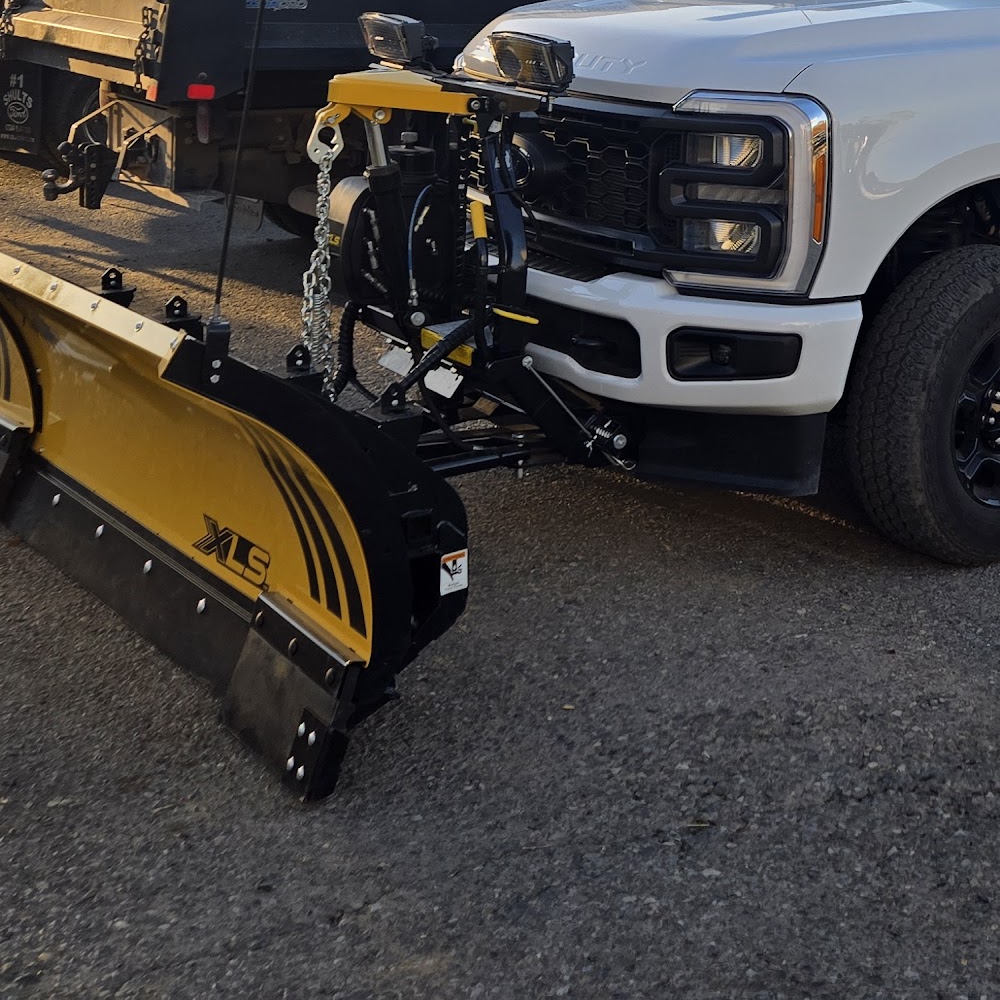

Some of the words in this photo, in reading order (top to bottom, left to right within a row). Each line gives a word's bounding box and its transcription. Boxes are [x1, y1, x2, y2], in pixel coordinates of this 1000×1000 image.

[574, 53, 647, 75] UTY
[10, 74, 24, 88] #1
[3, 89, 33, 108] SHULTS
[191, 513, 271, 591] XLS
